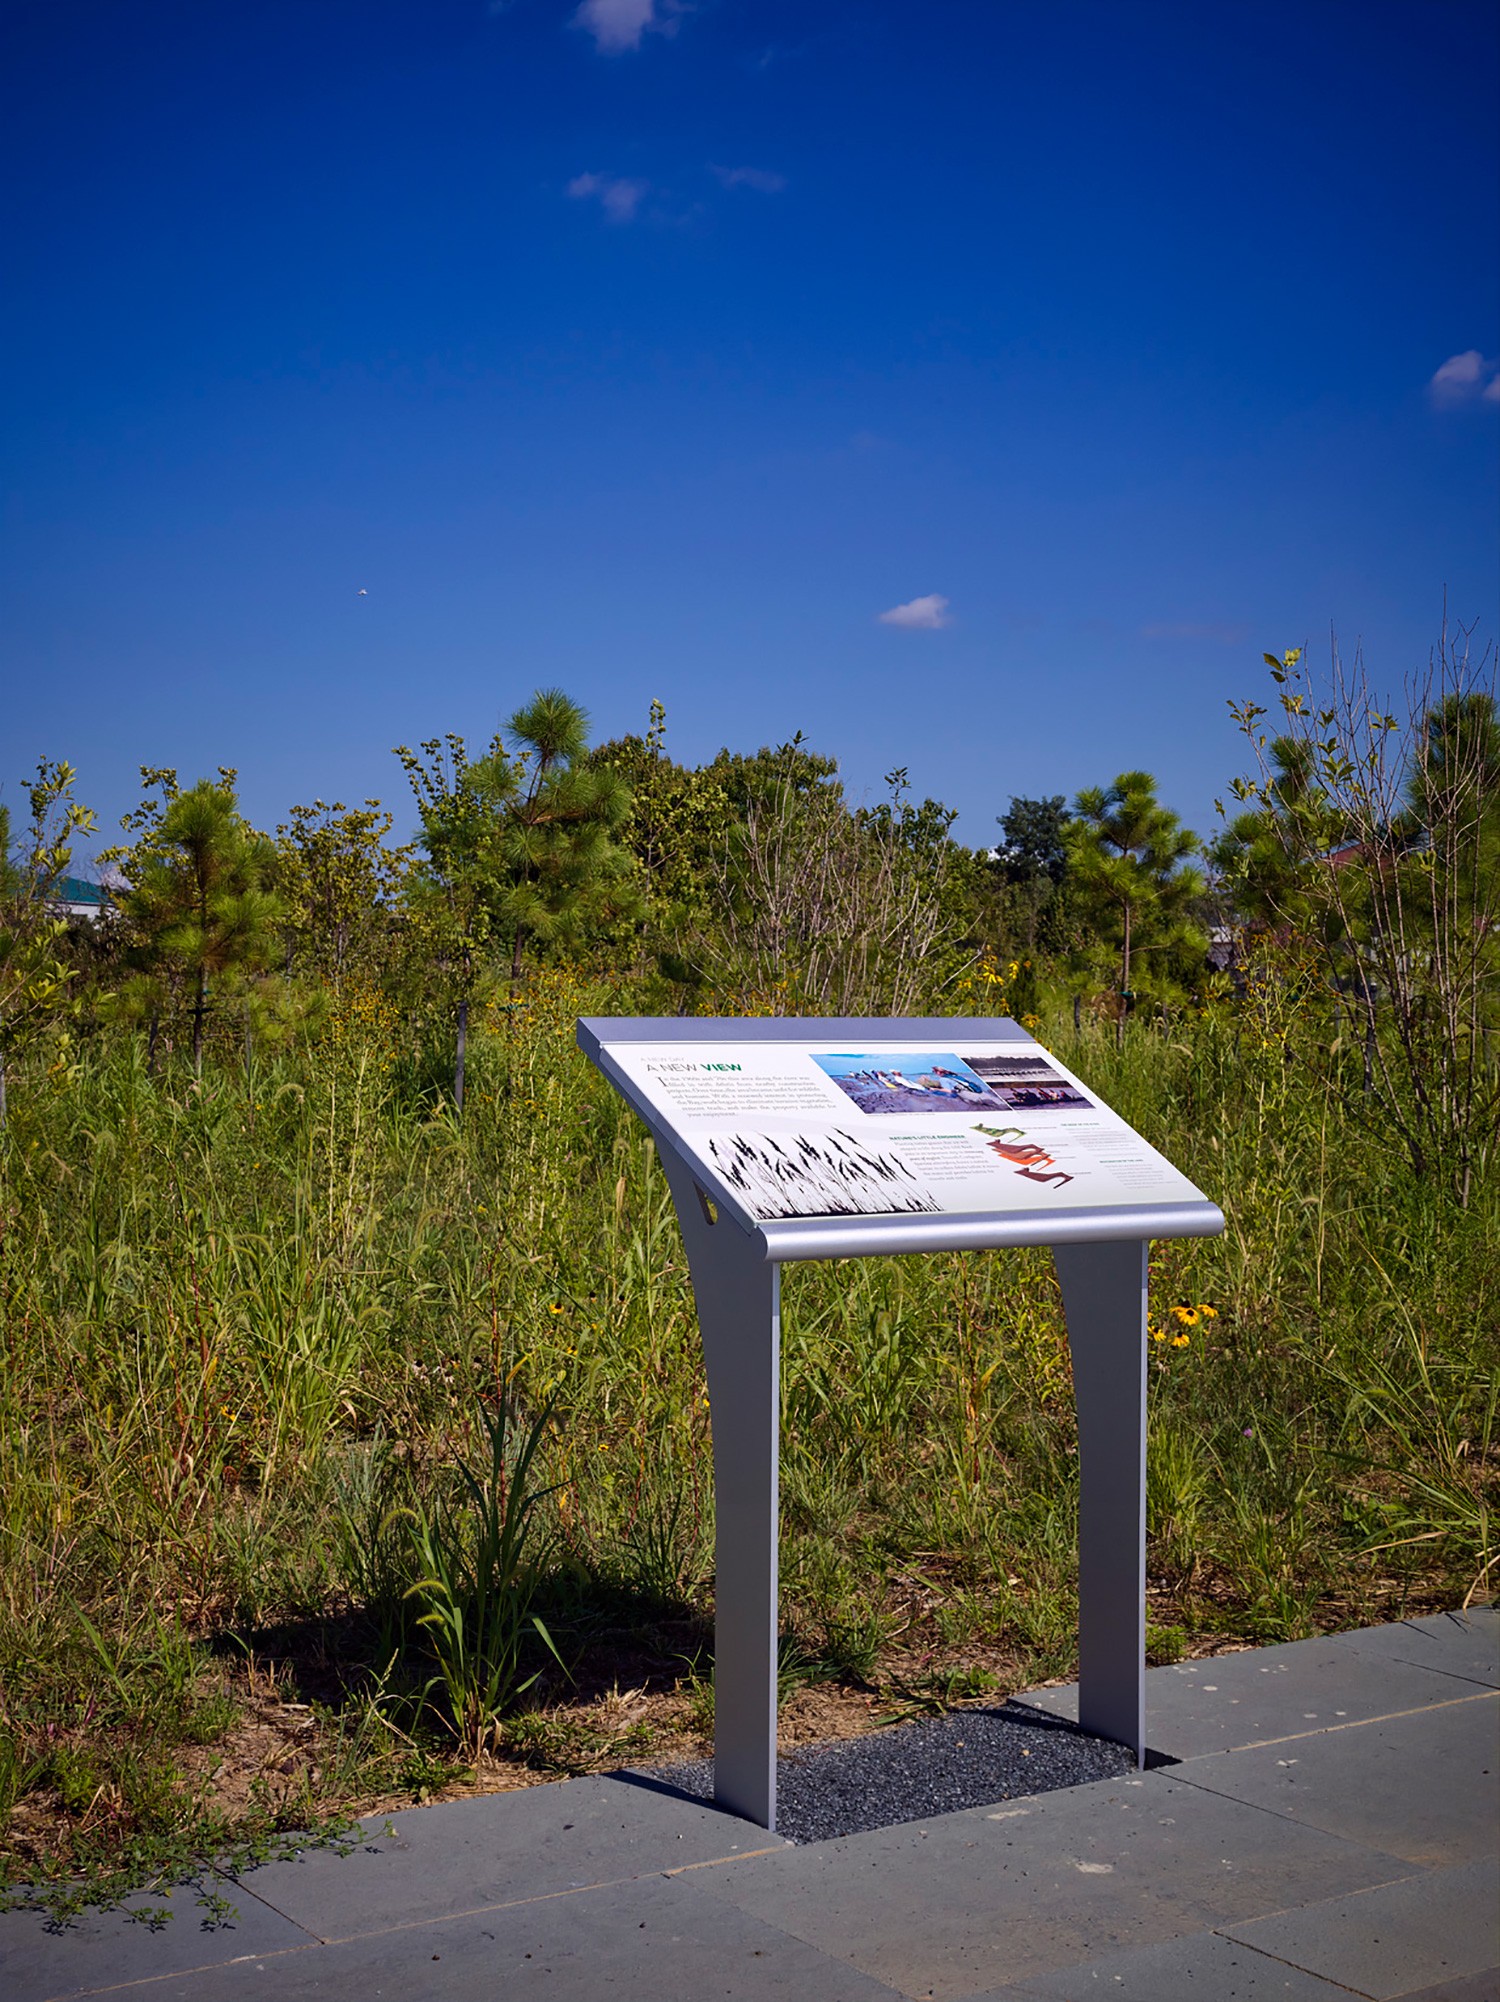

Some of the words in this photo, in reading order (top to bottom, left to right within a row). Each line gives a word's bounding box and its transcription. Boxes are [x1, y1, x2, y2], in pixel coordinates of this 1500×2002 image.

[647, 1064, 659, 1072] A
[660, 1063, 697, 1072] NEW
[700, 1063, 742, 1072] VIEW
